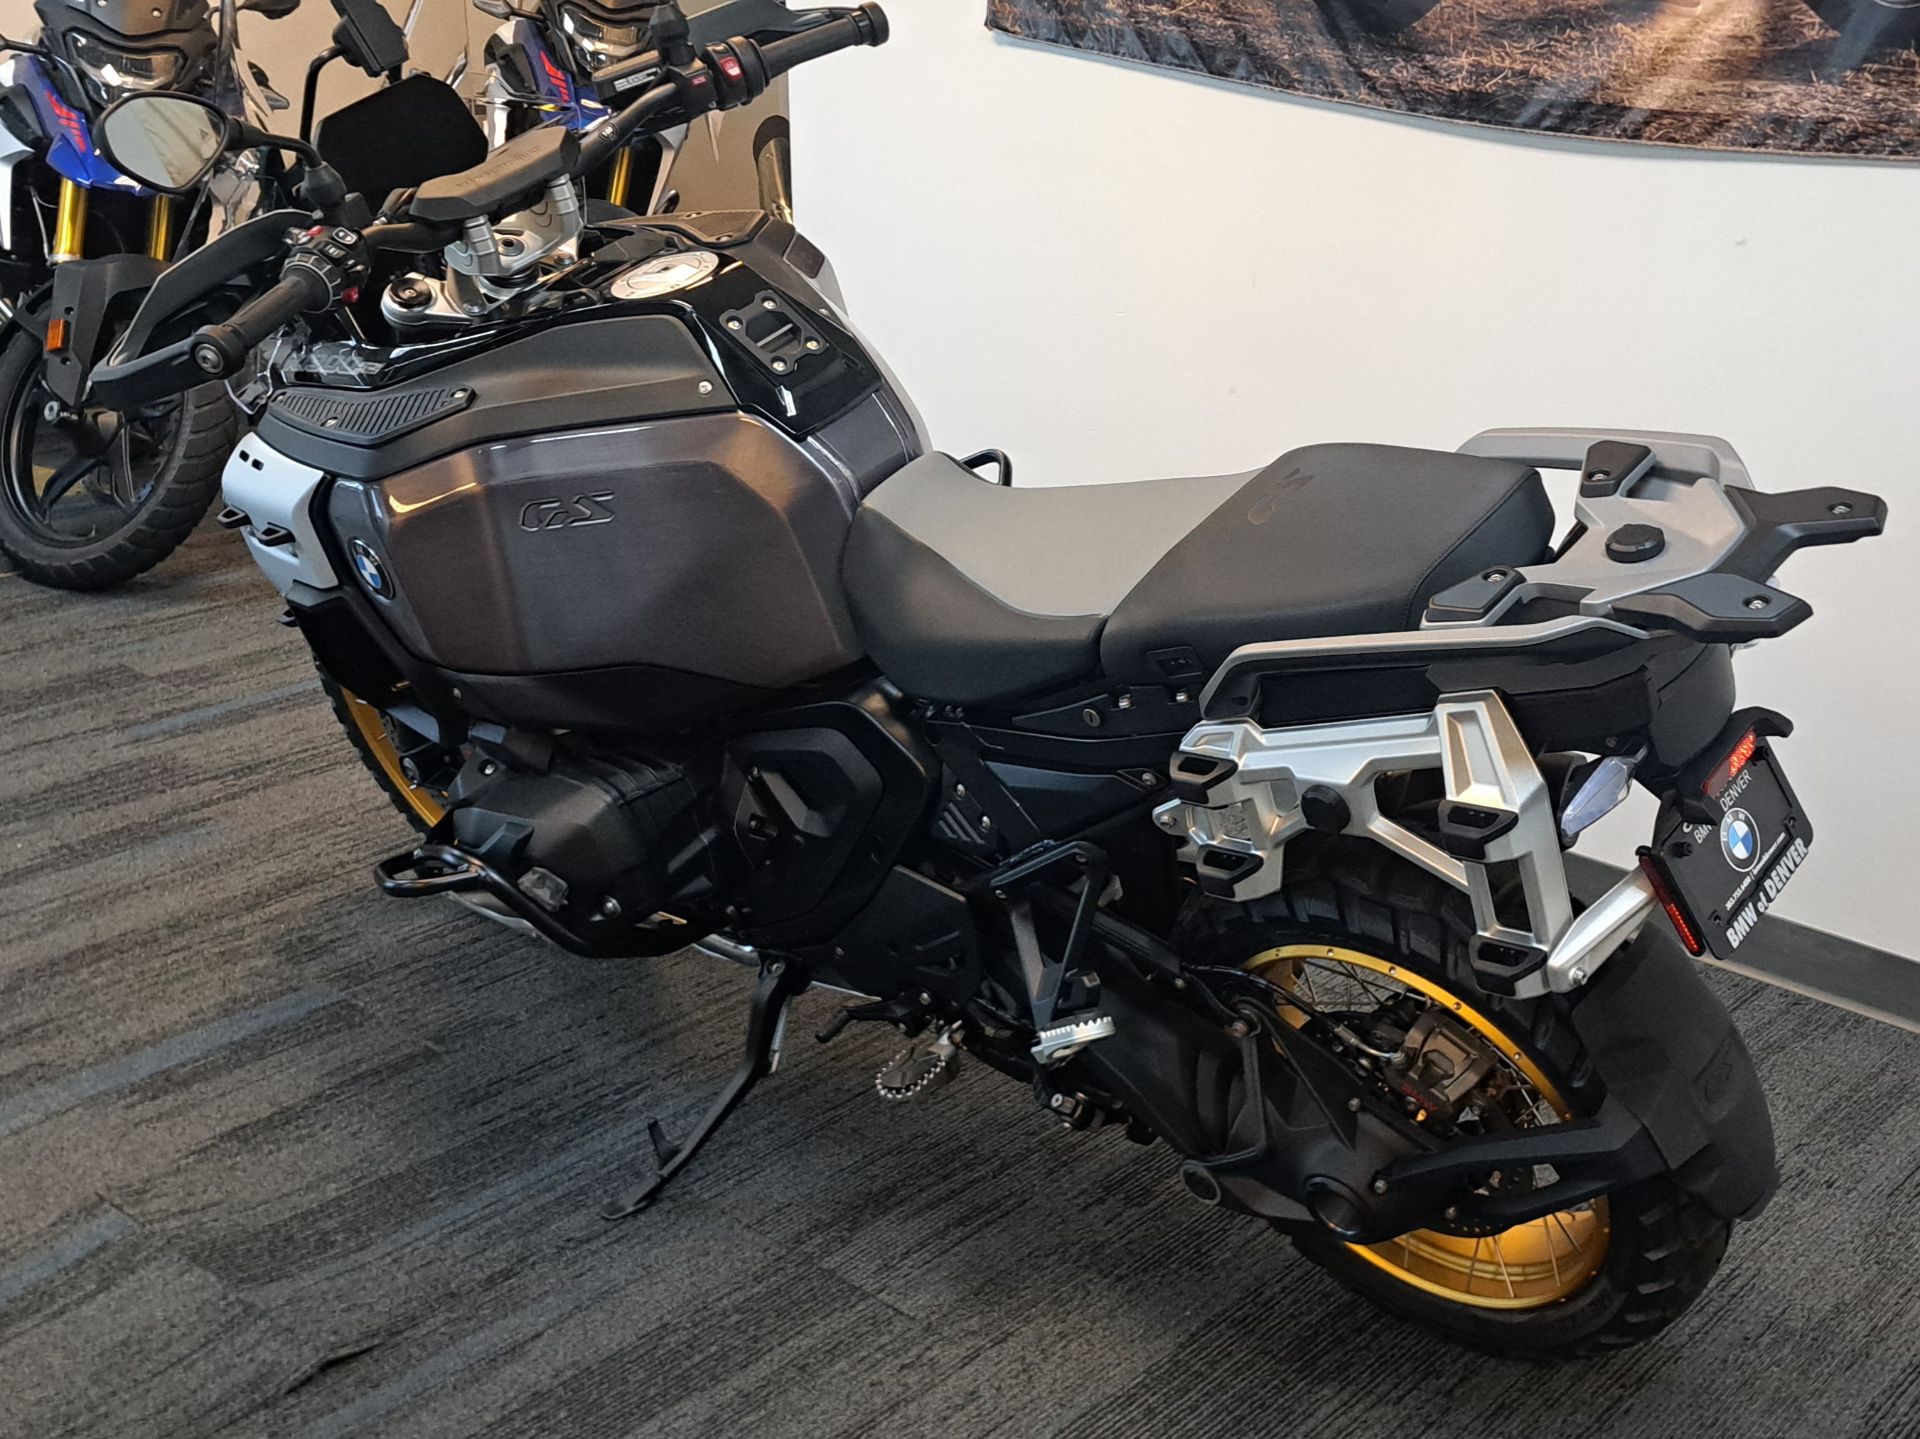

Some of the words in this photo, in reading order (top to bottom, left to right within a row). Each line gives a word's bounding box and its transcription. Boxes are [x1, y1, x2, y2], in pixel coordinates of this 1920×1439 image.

[519, 489, 616, 532] GS
[1719, 769, 1753, 812] DENVER
[1725, 908, 1758, 950] BMW
[1757, 892, 1769, 913] of
[1763, 837, 1809, 901] DENVER
